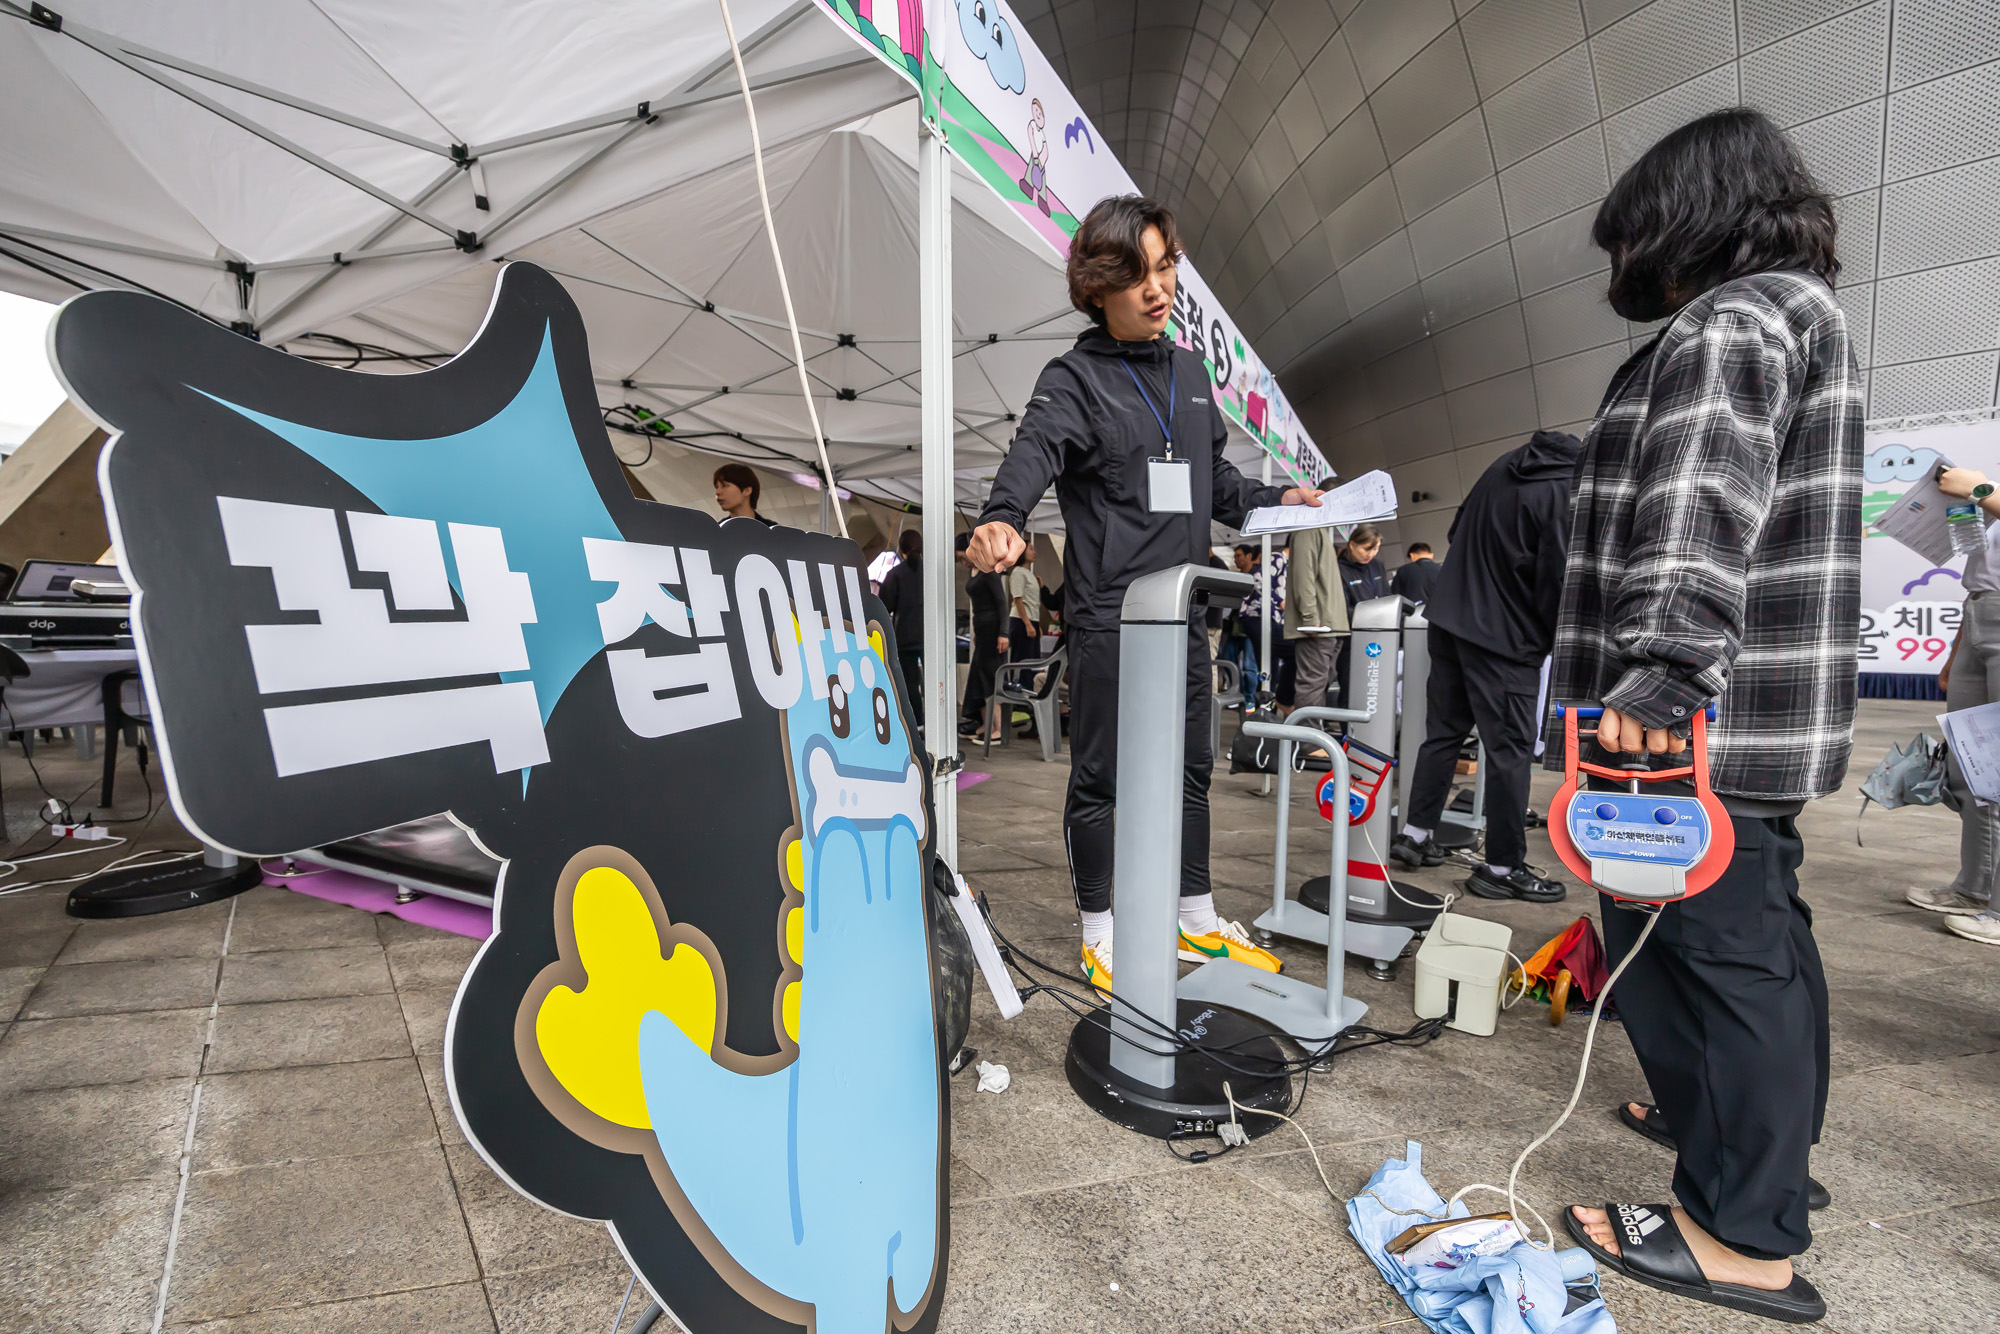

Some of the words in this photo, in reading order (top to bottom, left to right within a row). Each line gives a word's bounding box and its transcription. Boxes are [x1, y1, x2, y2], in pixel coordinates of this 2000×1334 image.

[28, 619, 57, 631] ddp
[216, 496, 550, 777] 꽉
[1896, 637, 1953, 662] 99
